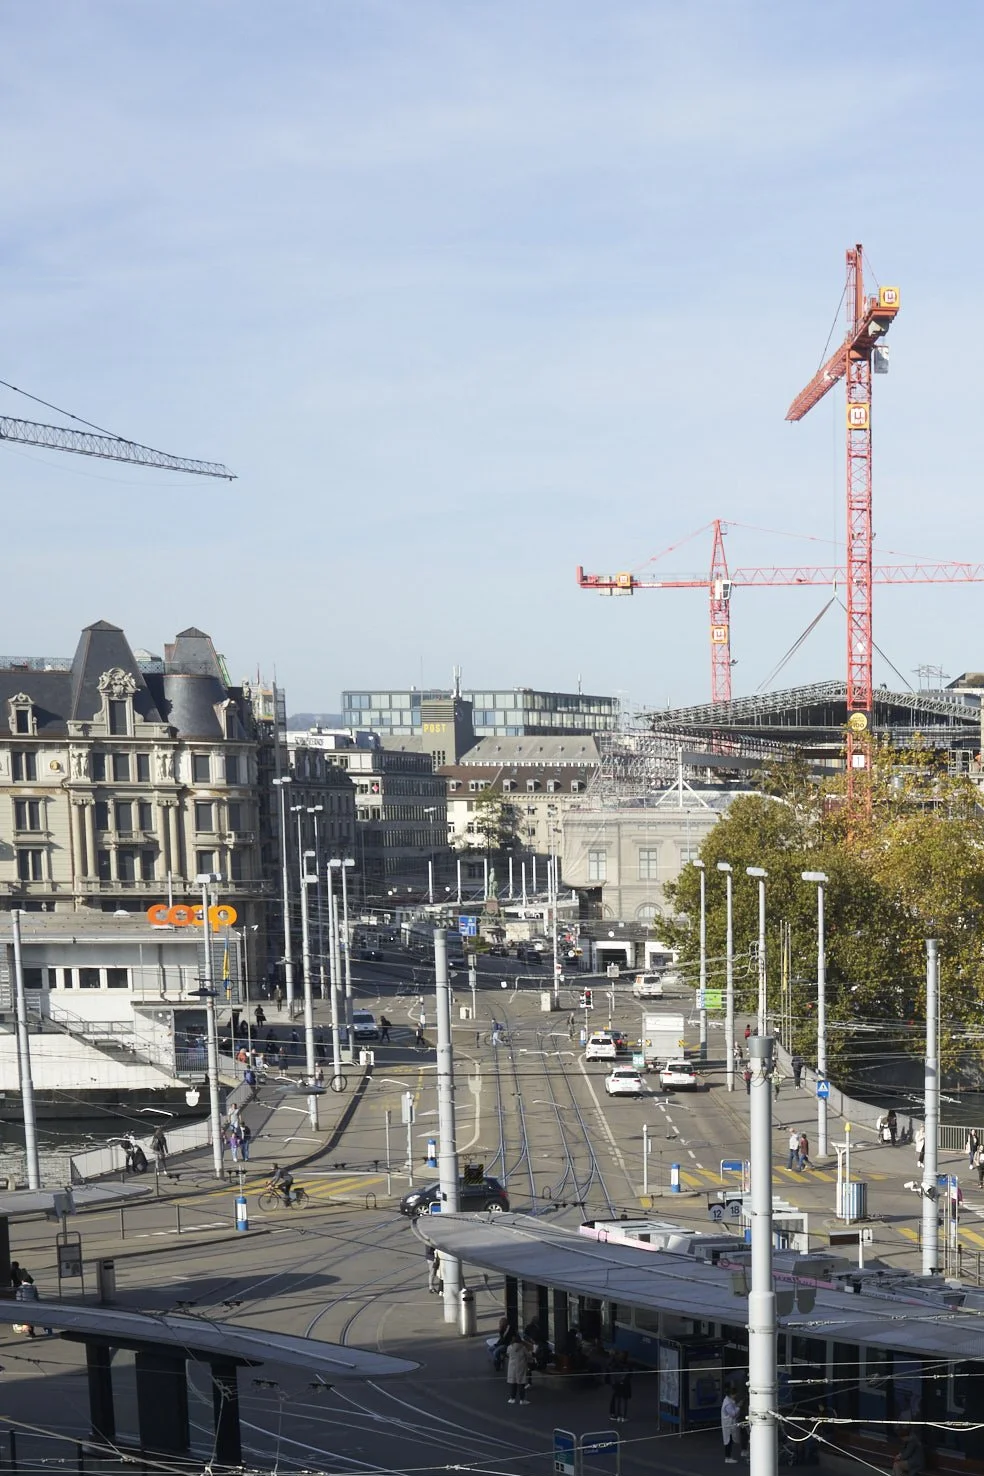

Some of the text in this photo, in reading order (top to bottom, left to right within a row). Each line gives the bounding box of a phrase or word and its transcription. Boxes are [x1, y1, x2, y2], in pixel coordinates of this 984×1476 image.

[423, 723, 448, 734] POST
[146, 904, 238, 934] coop
[712, 1209, 722, 1219] 12
[730, 1205, 740, 1215] 18
